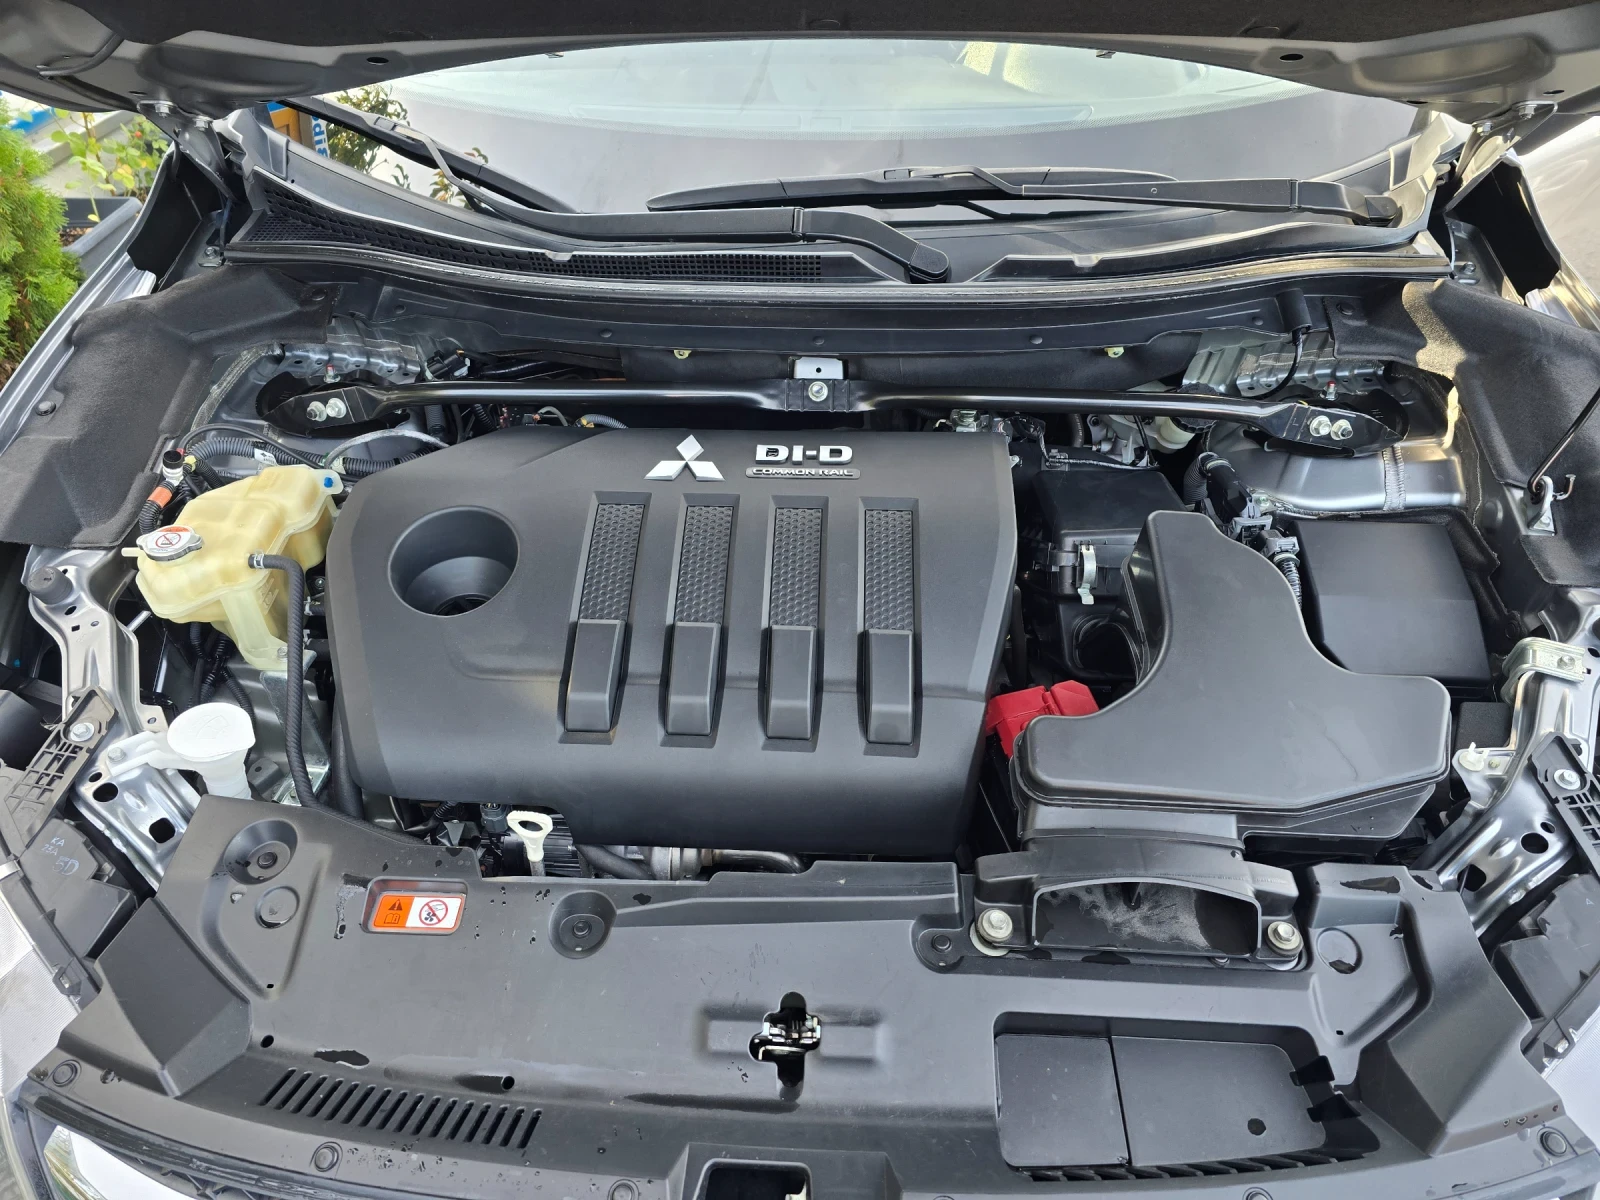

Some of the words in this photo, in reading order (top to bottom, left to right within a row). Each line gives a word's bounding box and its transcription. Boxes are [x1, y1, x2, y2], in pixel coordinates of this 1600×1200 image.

[755, 444, 853, 465] DI-D
[752, 468, 815, 477] COMMON
[819, 468, 854, 477] RAIL
